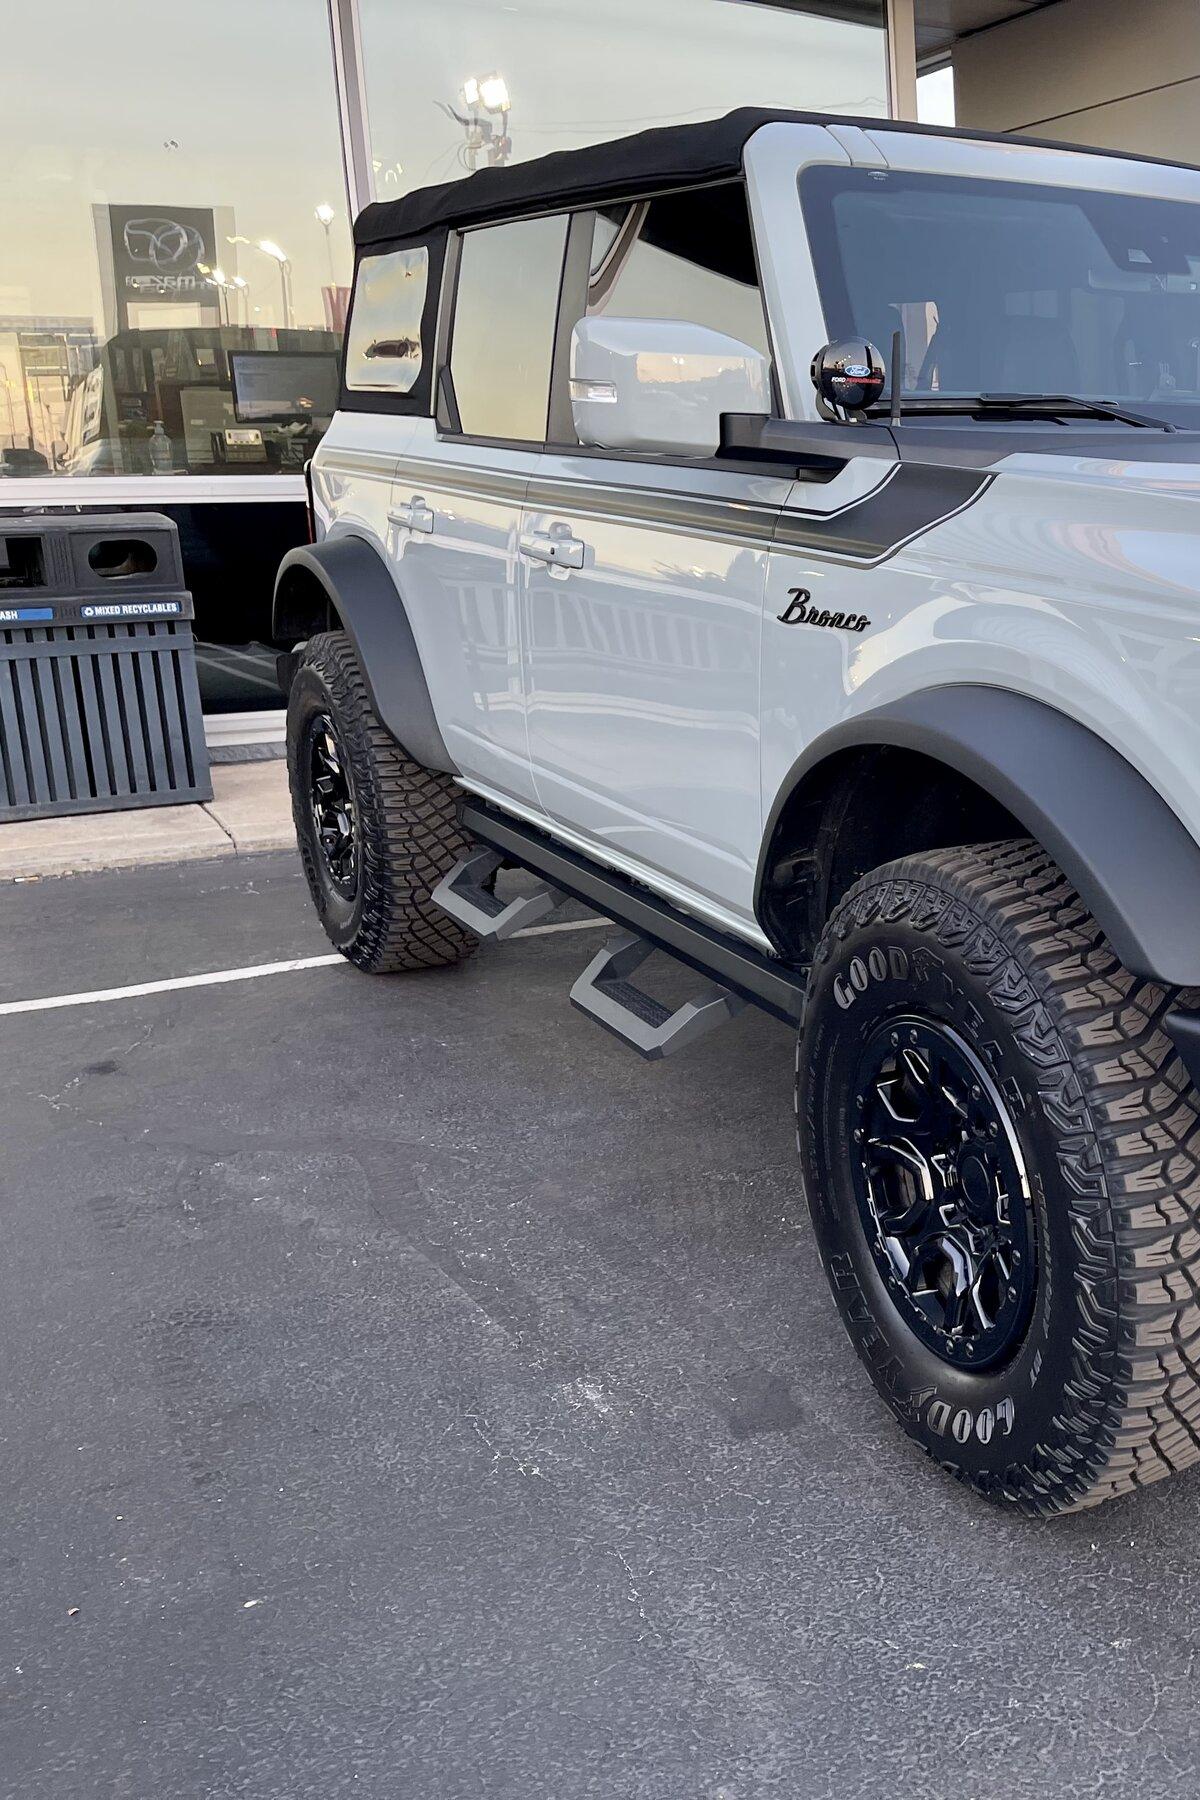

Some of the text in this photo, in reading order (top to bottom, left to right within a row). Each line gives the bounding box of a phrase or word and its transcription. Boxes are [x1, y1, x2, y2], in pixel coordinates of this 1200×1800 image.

[95, 602, 177, 616] MIXED RECYCLABLES
[777, 587, 871, 632] Bronco
